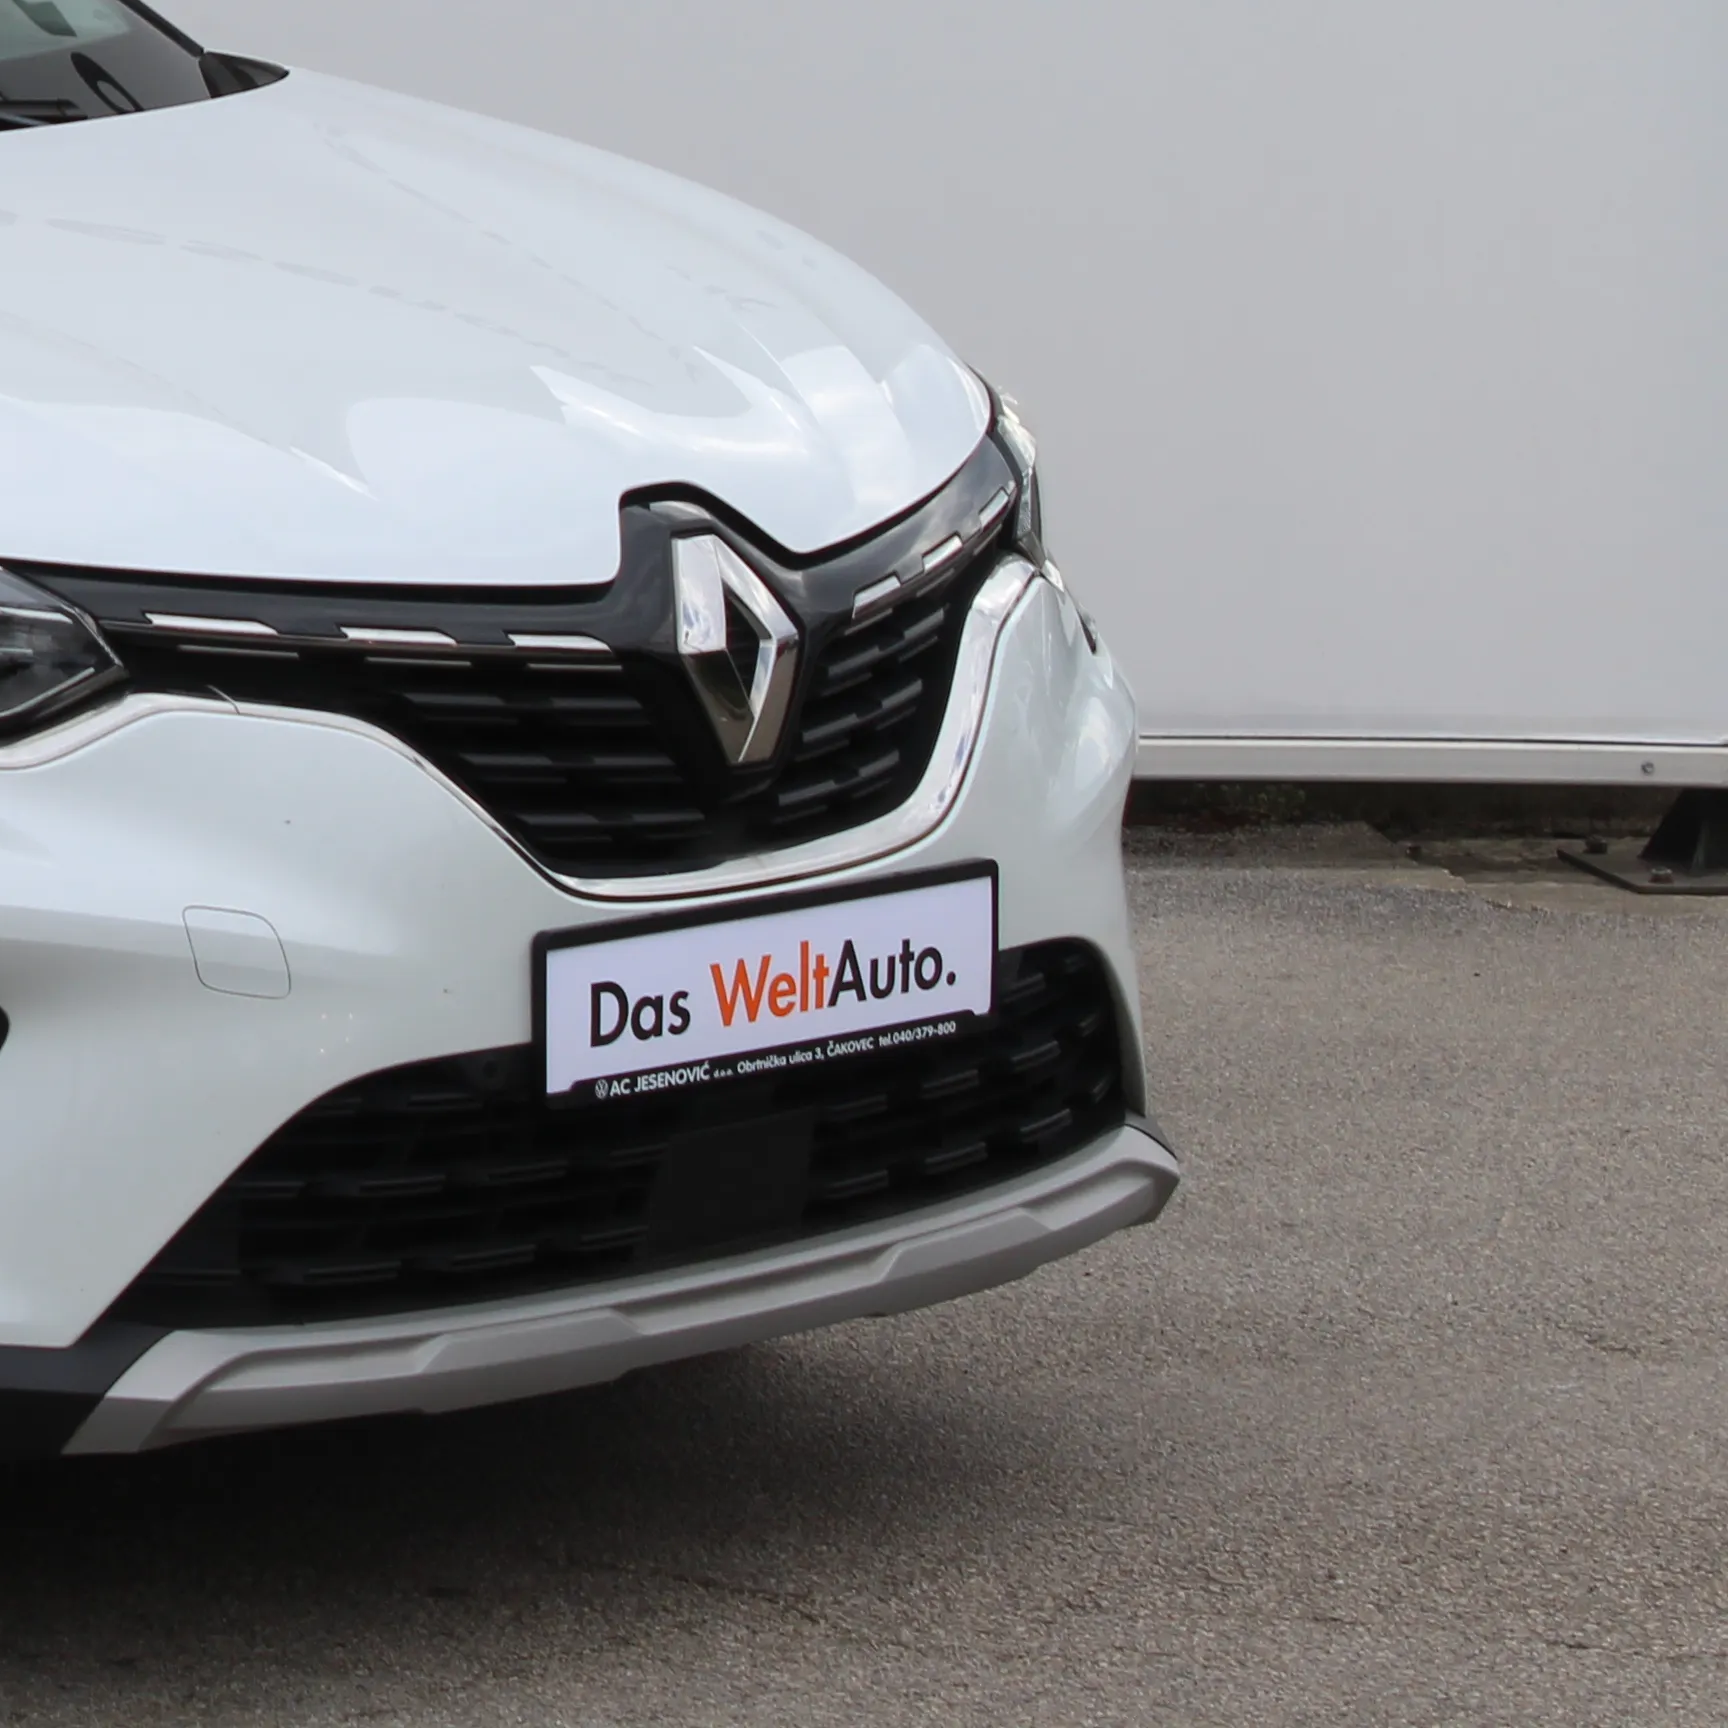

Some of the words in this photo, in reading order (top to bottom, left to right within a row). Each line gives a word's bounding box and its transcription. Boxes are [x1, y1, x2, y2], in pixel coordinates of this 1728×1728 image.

[590, 981, 691, 1048] Das
[709, 938, 957, 1027] WeltAuto.
[610, 1078, 631, 1097] AC
[633, 1060, 711, 1093] JESENOVIĆ
[737, 1054, 787, 1075] Obrtnička
[788, 1050, 813, 1065] ulica
[814, 1046, 825, 1061] 3,
[827, 1039, 875, 1058] ČAKOVEC
